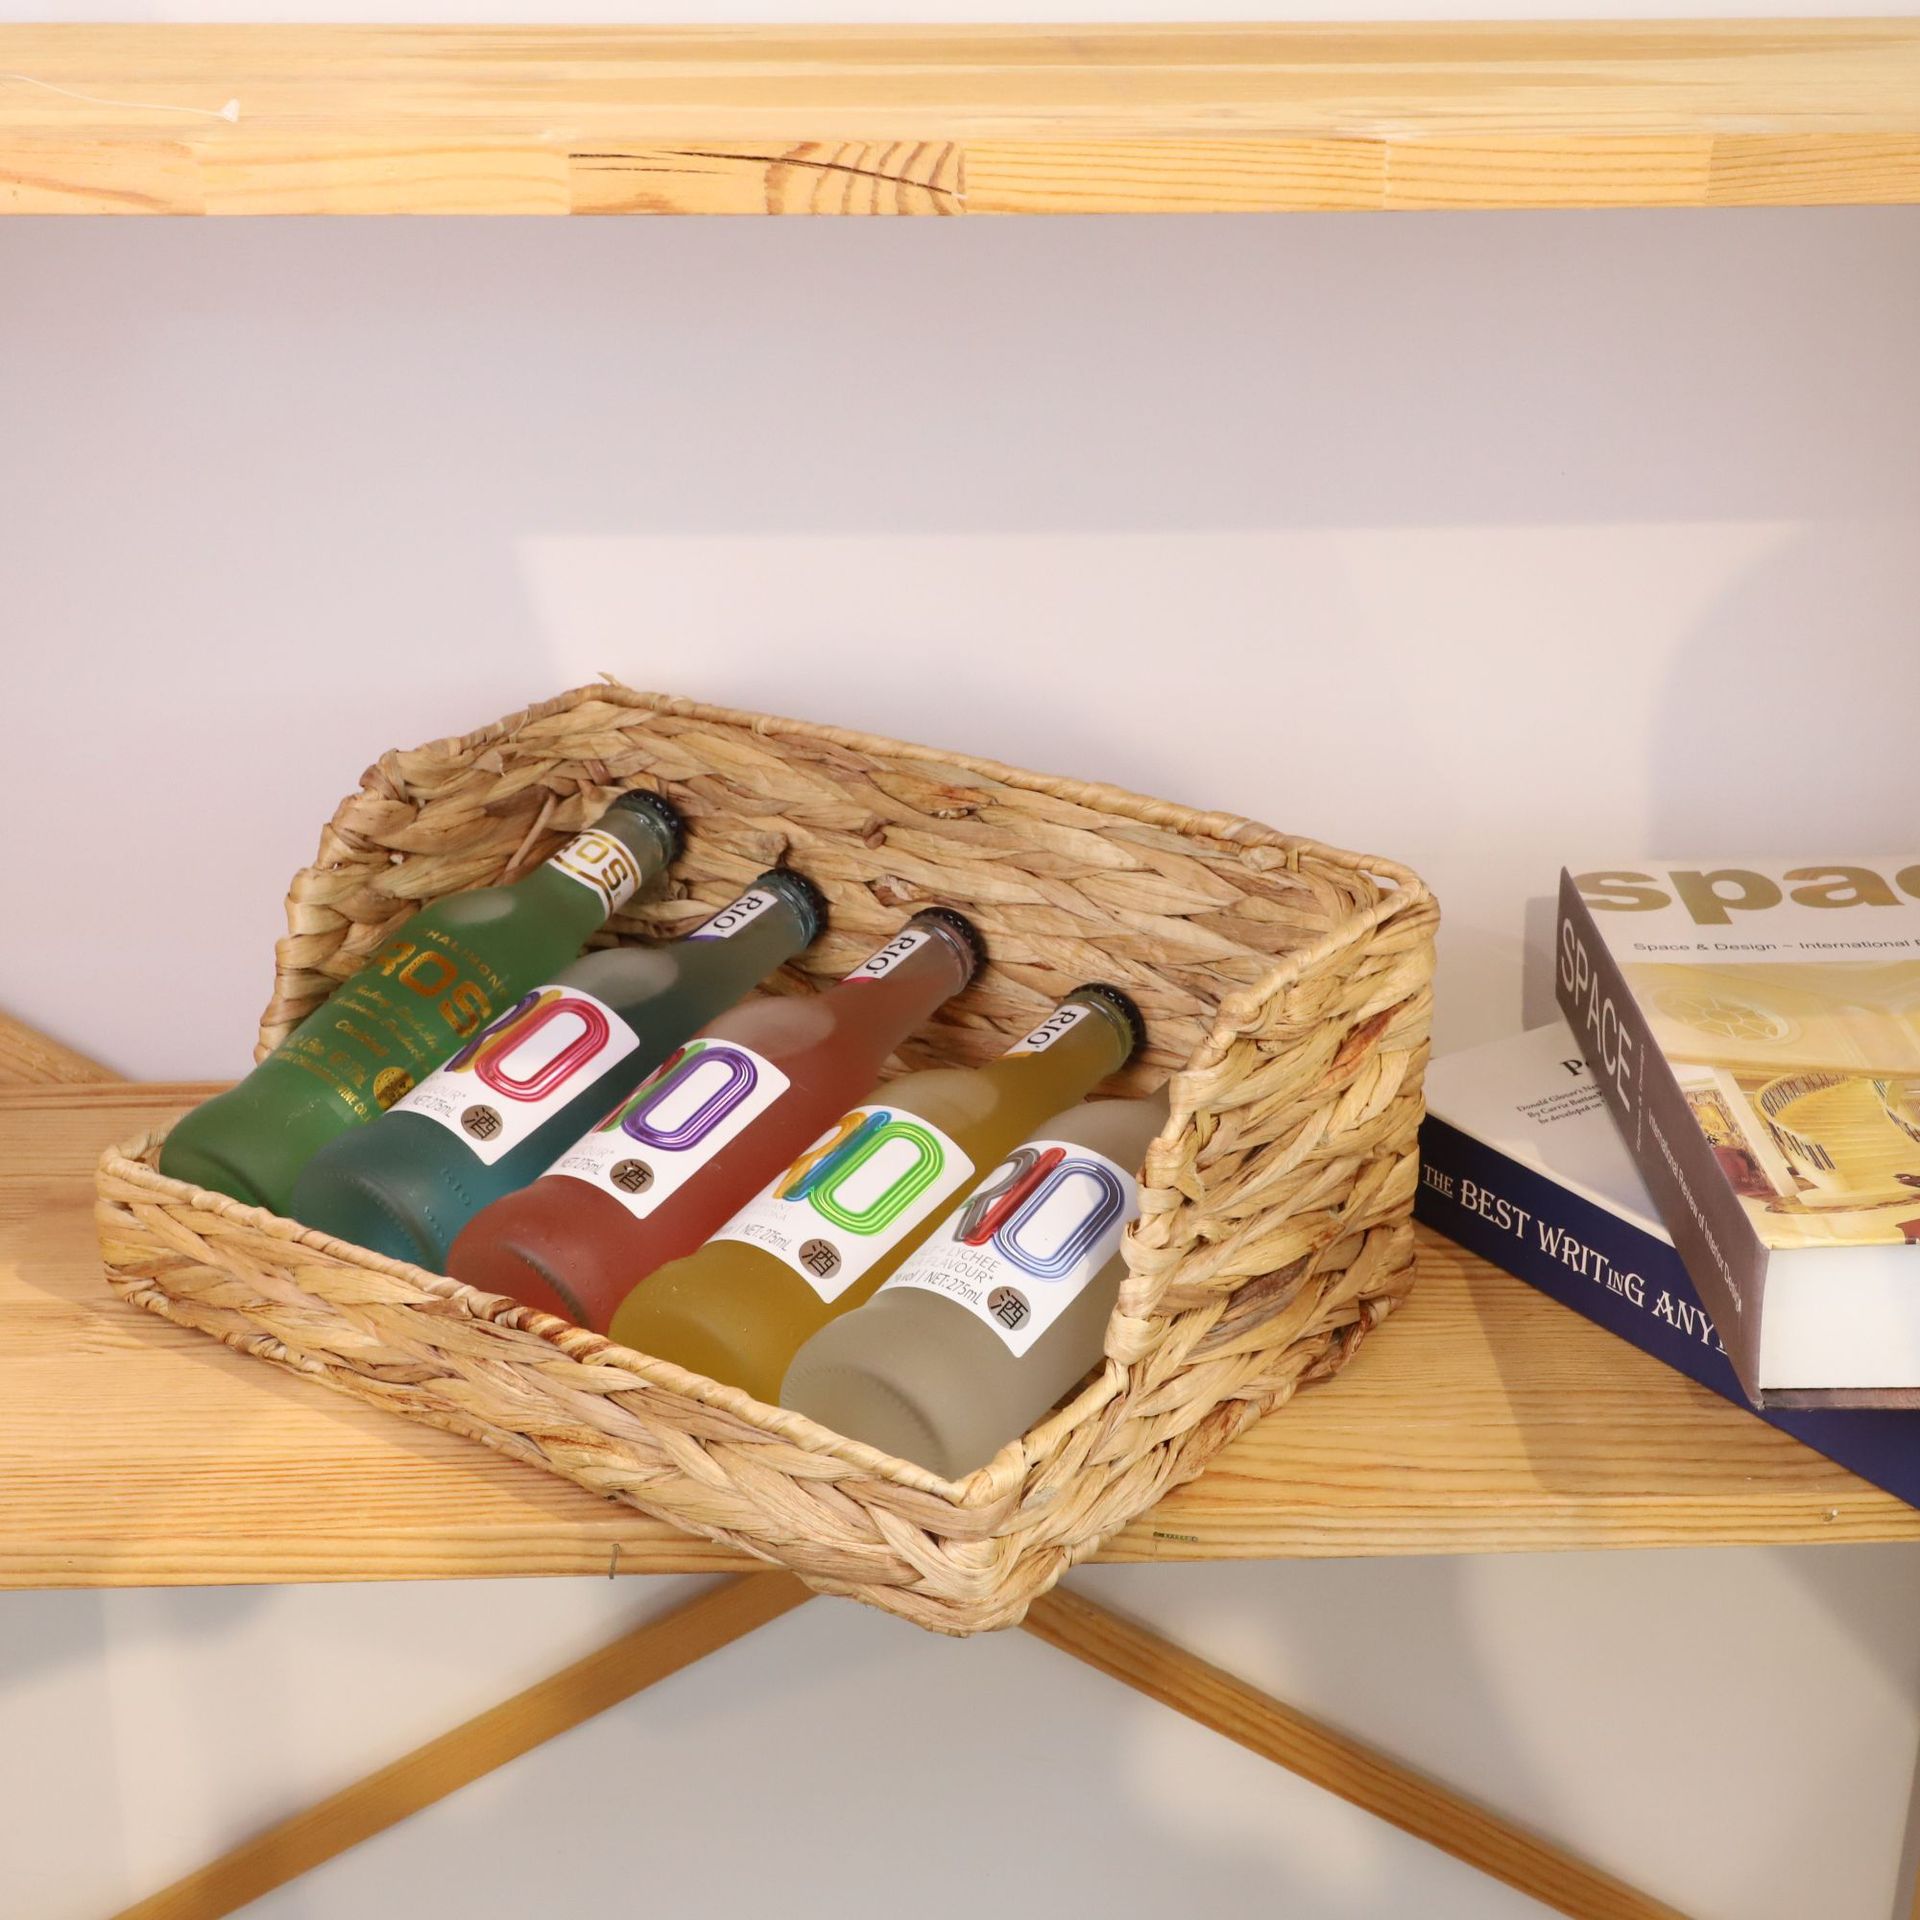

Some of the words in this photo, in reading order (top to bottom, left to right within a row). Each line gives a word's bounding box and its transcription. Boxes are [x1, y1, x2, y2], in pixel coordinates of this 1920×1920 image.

[1573, 865, 1920, 925] spa
[713, 896, 764, 934] RIO
[866, 935, 916, 972] RIO
[1633, 941, 1690, 952] Space
[1696, 942, 1709, 951] &
[1714, 941, 1777, 952] Design
[1799, 938, 1911, 950] International
[1026, 1010, 1078, 1047] RIO
[1560, 917, 1632, 1112] SPACE
[463, 1107, 501, 1140] 酒
[612, 1161, 652, 1193] 酒
[1424, 1165, 1454, 1198] THE
[1461, 1178, 1531, 1239] BEST
[801, 1240, 840, 1277] 酒
[990, 1289, 1029, 1330] 酒
